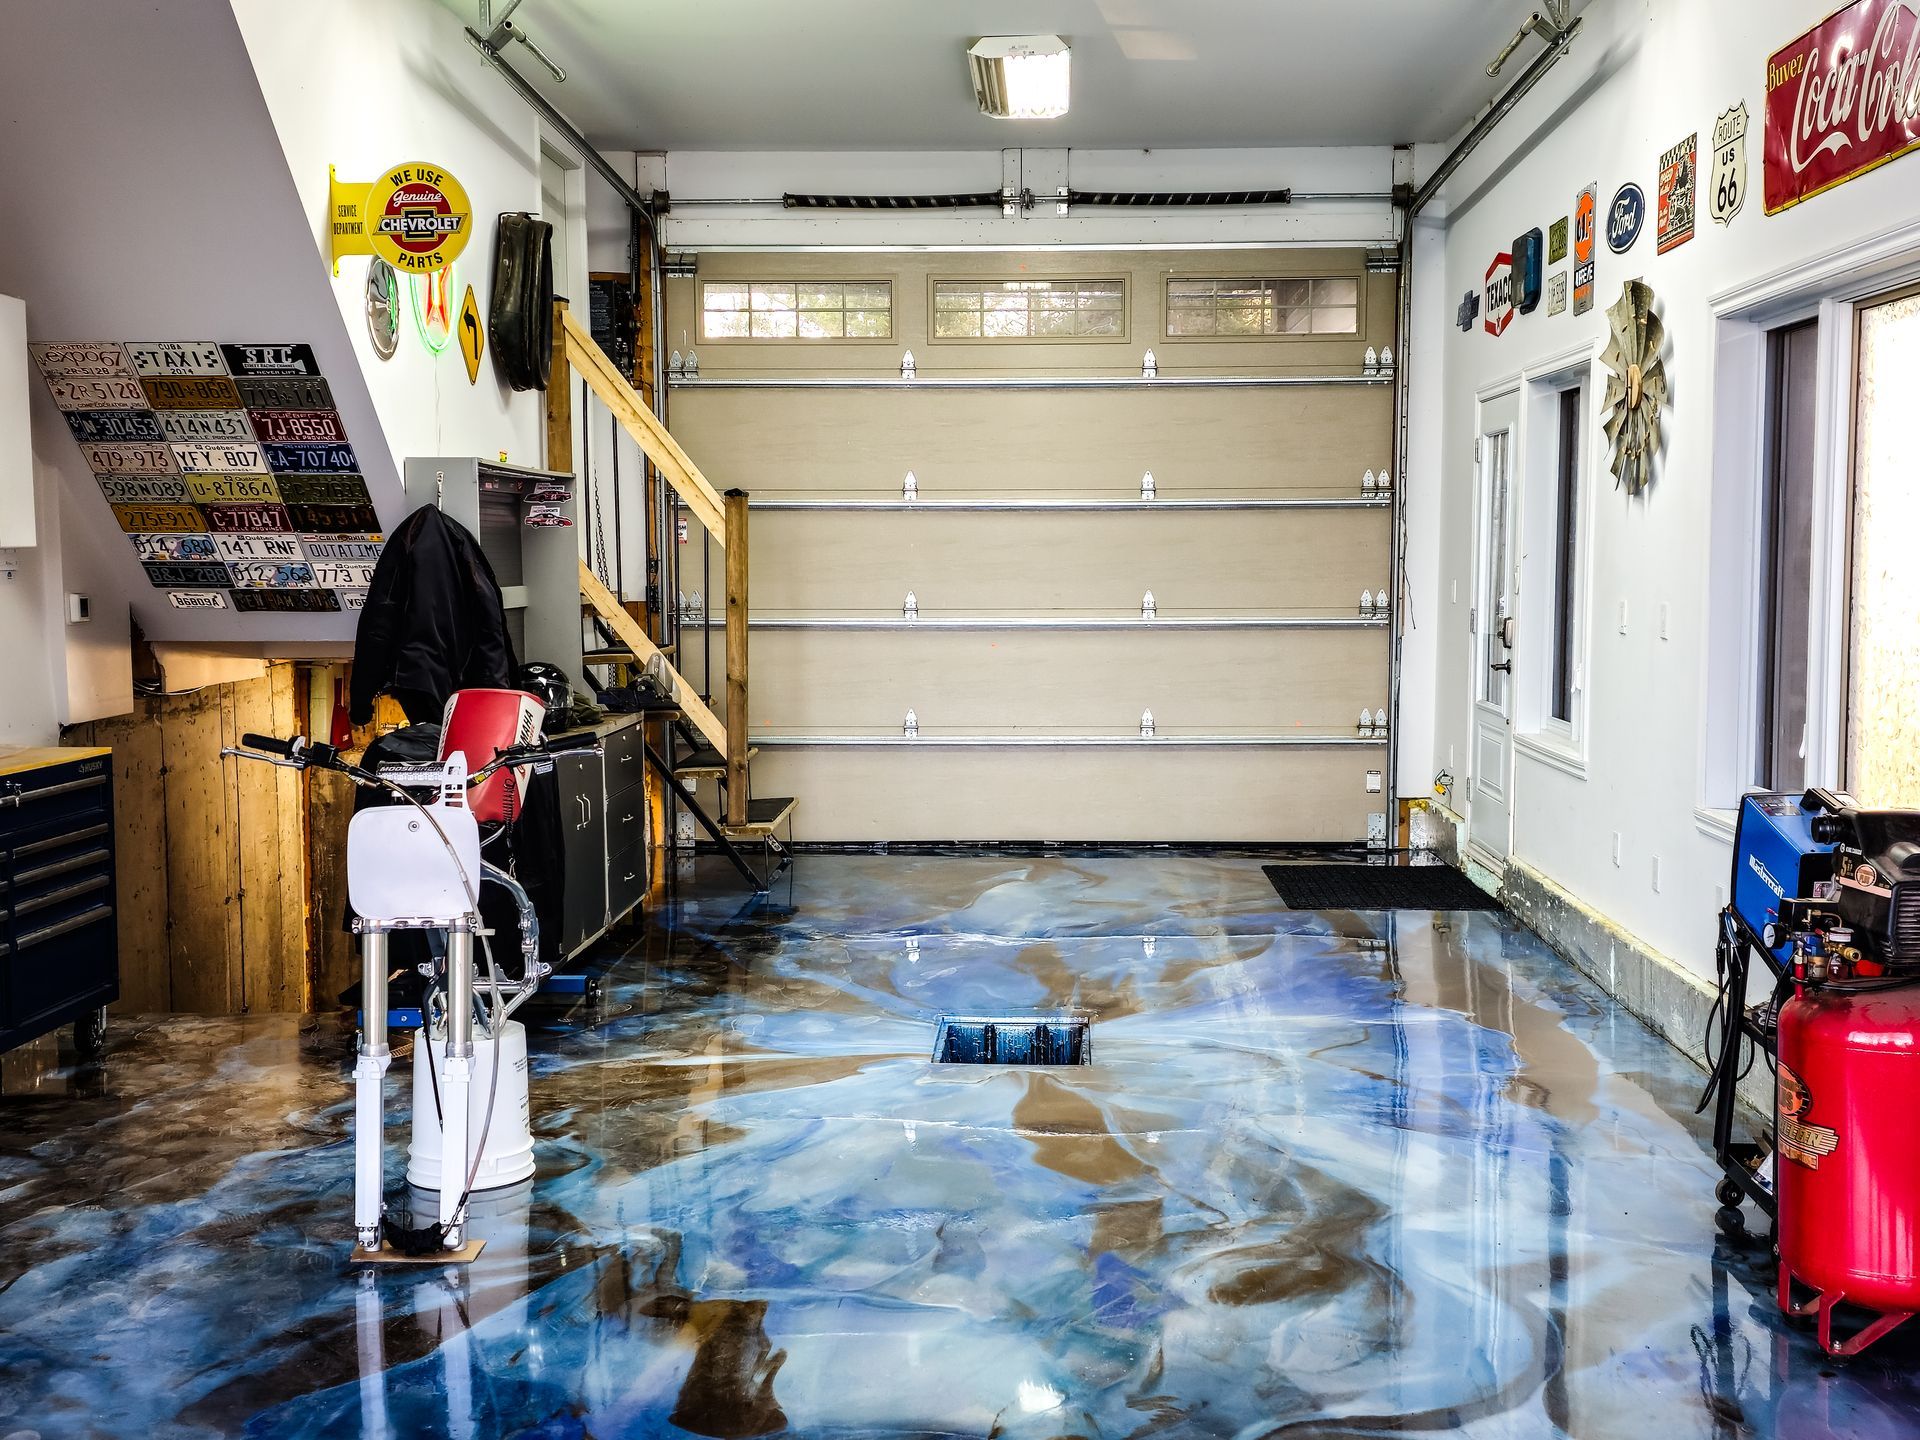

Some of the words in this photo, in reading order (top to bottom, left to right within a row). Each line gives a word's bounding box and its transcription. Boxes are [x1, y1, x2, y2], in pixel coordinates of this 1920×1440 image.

[1768, 54, 1804, 93] Buvez
[1718, 115, 1741, 144] ROUTE
[1722, 148, 1735, 166] US
[390, 170, 412, 187] WE
[417, 169, 443, 186] USE
[1718, 168, 1737, 212] 66
[393, 191, 442, 207] Genuine
[338, 205, 357, 217] SERVICE
[1612, 196, 1636, 238] Ford
[333, 222, 363, 235] DEPARTMENT
[381, 218, 459, 231] CHEVROLET
[398, 252, 443, 269] PARTS
[146, 351, 202, 367] TAXI
[165, 419, 248, 434] 414N431
[262, 419, 337, 435] 7J-8550
[93, 451, 123, 466] 479
[133, 451, 168, 467] 973
[176, 451, 212, 466] YFY
[224, 451, 258, 466] 807
[102, 481, 184, 497] 598N089
[194, 482, 272, 496] U-87864
[125, 511, 198, 526] 275E911
[213, 511, 280, 526] C-77847
[221, 541, 254, 554] 141
[264, 541, 296, 555] RNF
[309, 544, 382, 557] OUTATIME
[317, 569, 353, 582] 773
[1749, 854, 1786, 899] Mastercraft
